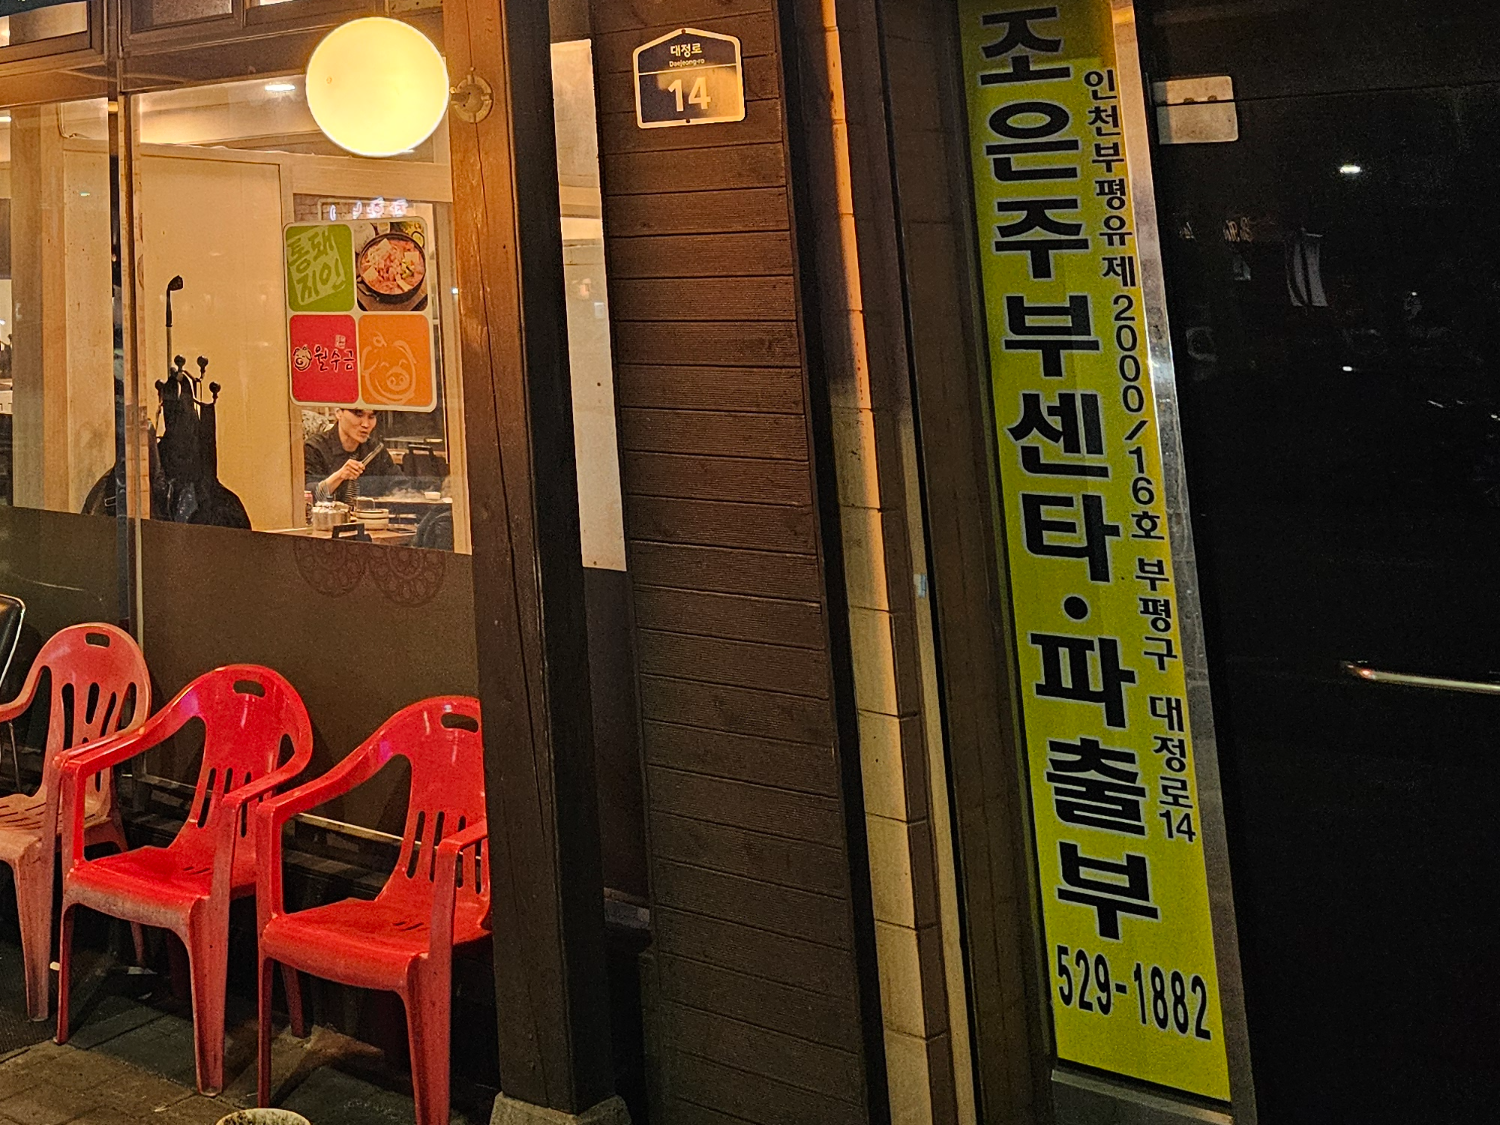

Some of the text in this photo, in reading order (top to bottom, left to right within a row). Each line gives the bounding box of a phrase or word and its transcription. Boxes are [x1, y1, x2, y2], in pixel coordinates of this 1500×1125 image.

[669, 42, 703, 58] 대정로
[667, 76, 712, 113] 14
[313, 344, 357, 374] 월수금
[1083, 69, 1133, 243] 인천부평유
[1135, 557, 1179, 672] 부평구
[1056, 944, 1212, 1041] 529-1882
